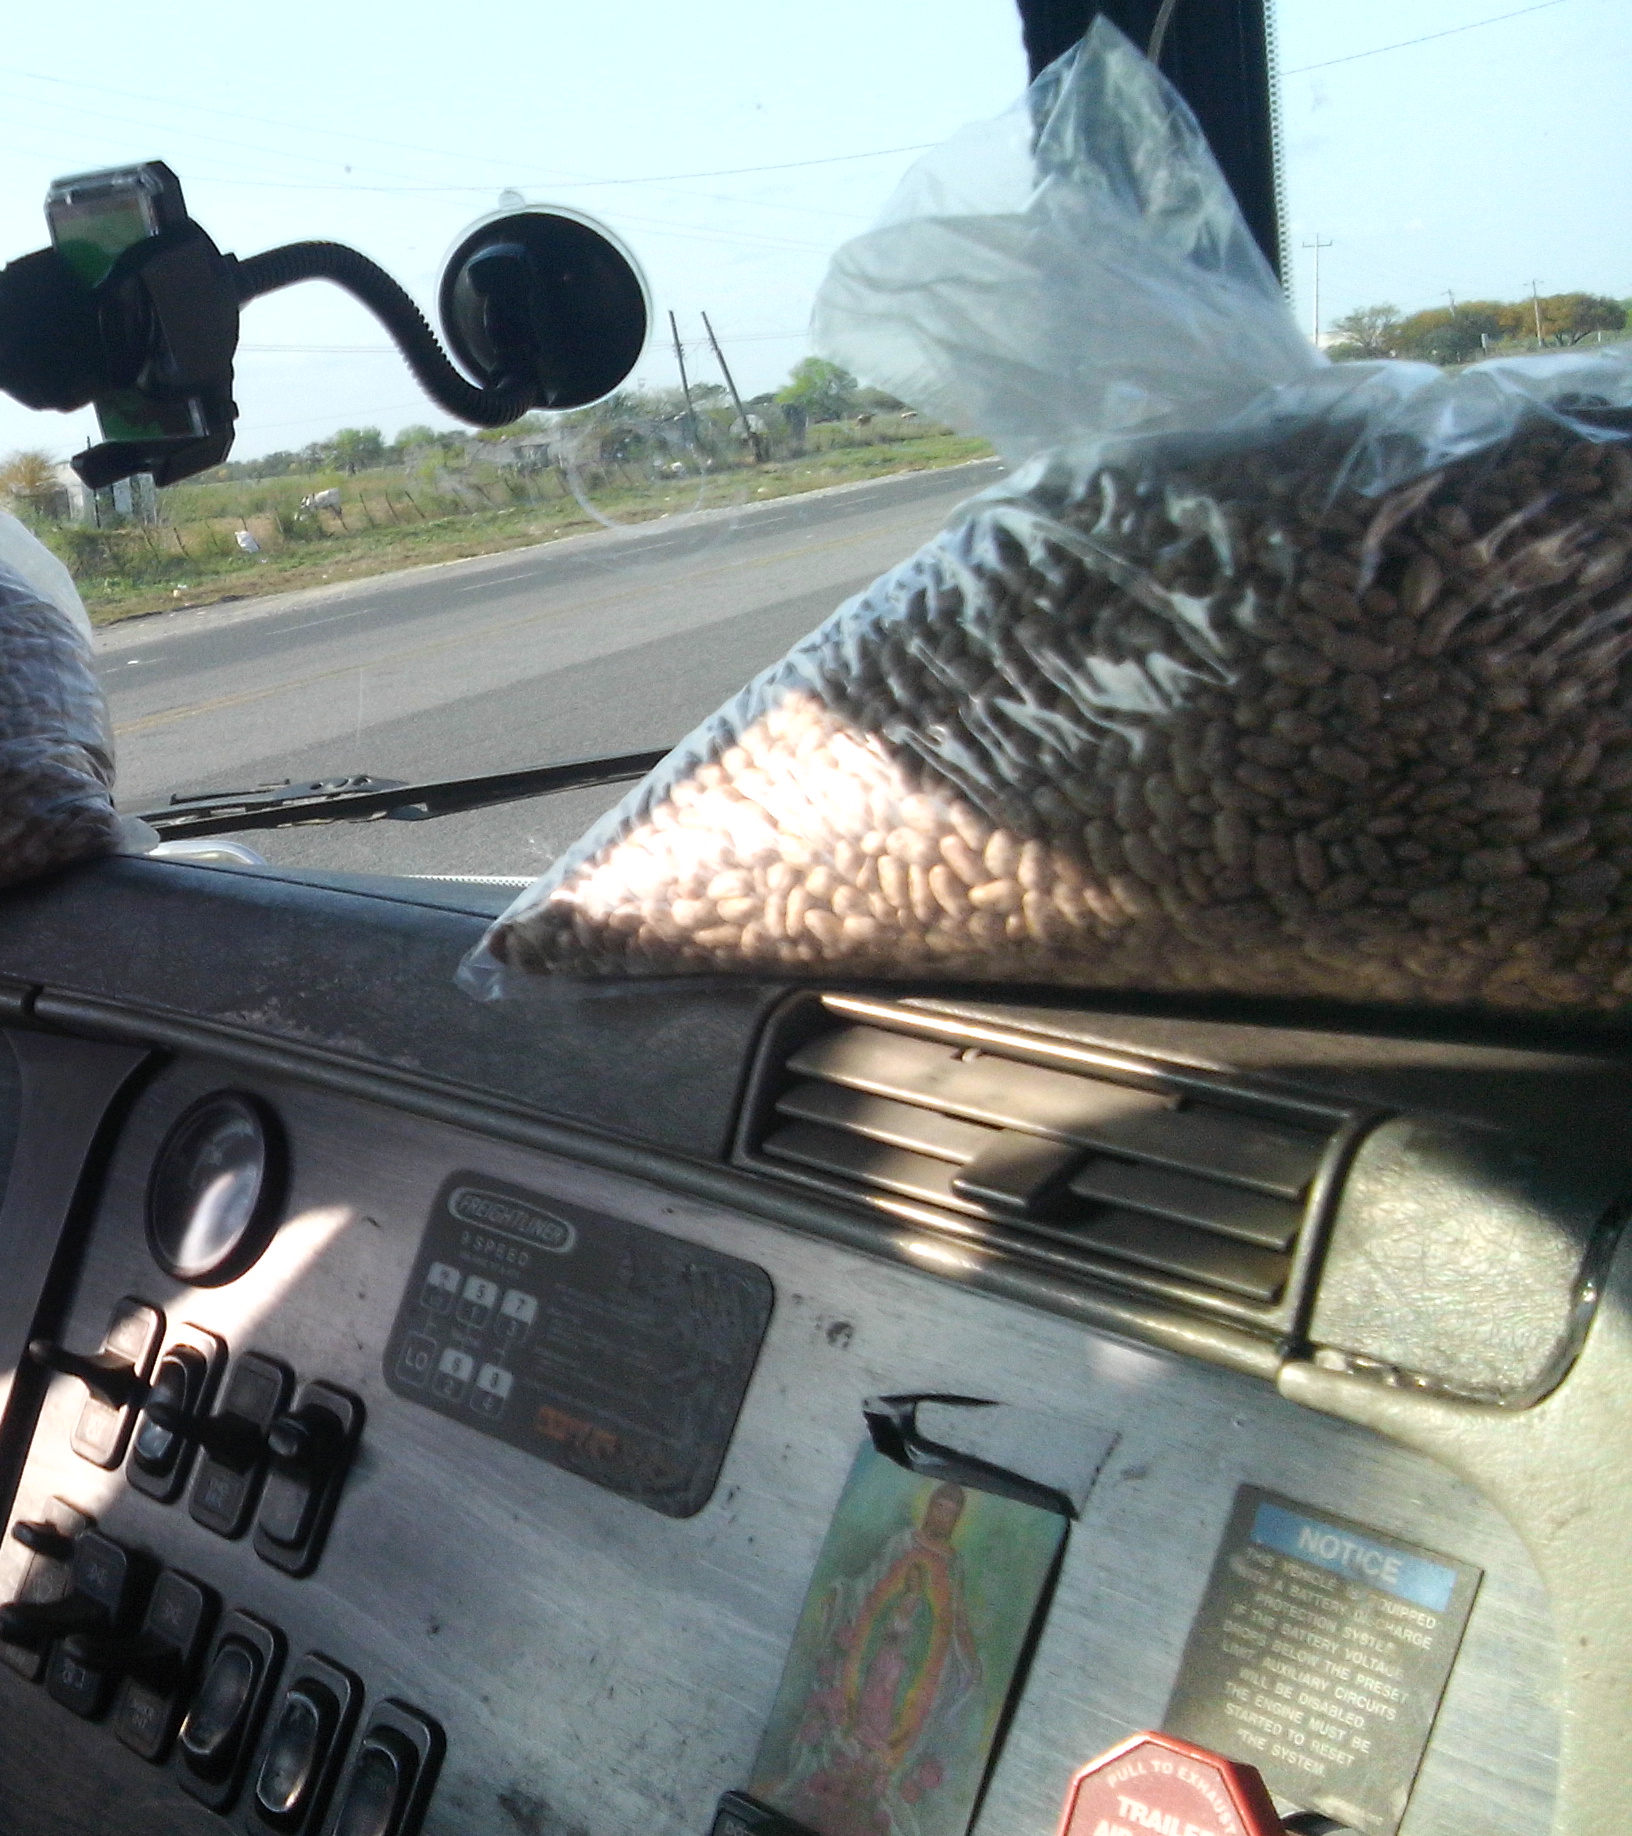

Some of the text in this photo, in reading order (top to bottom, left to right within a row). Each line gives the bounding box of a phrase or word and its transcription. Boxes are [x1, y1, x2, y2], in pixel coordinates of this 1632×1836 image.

[458, 1194, 564, 1242] FREIGHTLINER
[473, 1234, 529, 1266] SPEED
[405, 1345, 428, 1371] LO
[1247, 1546, 1275, 1569] THIS
[1282, 1560, 1338, 1592] VEHICLE
[1297, 1525, 1404, 1585] NOTICE
[1254, 1592, 1337, 1634] PROTECTION
[1274, 1579, 1284, 1593] A
[1289, 1583, 1349, 1616] BATTERY
[1230, 1600, 1247, 1615] IF
[1252, 1608, 1276, 1630] THE
[1281, 1622, 1340, 1655] BATTERY
[1223, 1619, 1410, 1705] DROPS BELOW THE PRESET
[1262, 1656, 1331, 1692] AUXILIARY
[1334, 1685, 1398, 1722] CIRCUITS
[1225, 1681, 1372, 1755] THE ENGINE MUST BE
[1240, 1667, 1366, 1731] WILL BE DISABLED.
[1224, 1702, 1356, 1769] STARTED TO RESET
[1237, 1727, 1267, 1751] THE
[1107, 1759, 1238, 1836] PULL TO EXHAUST
